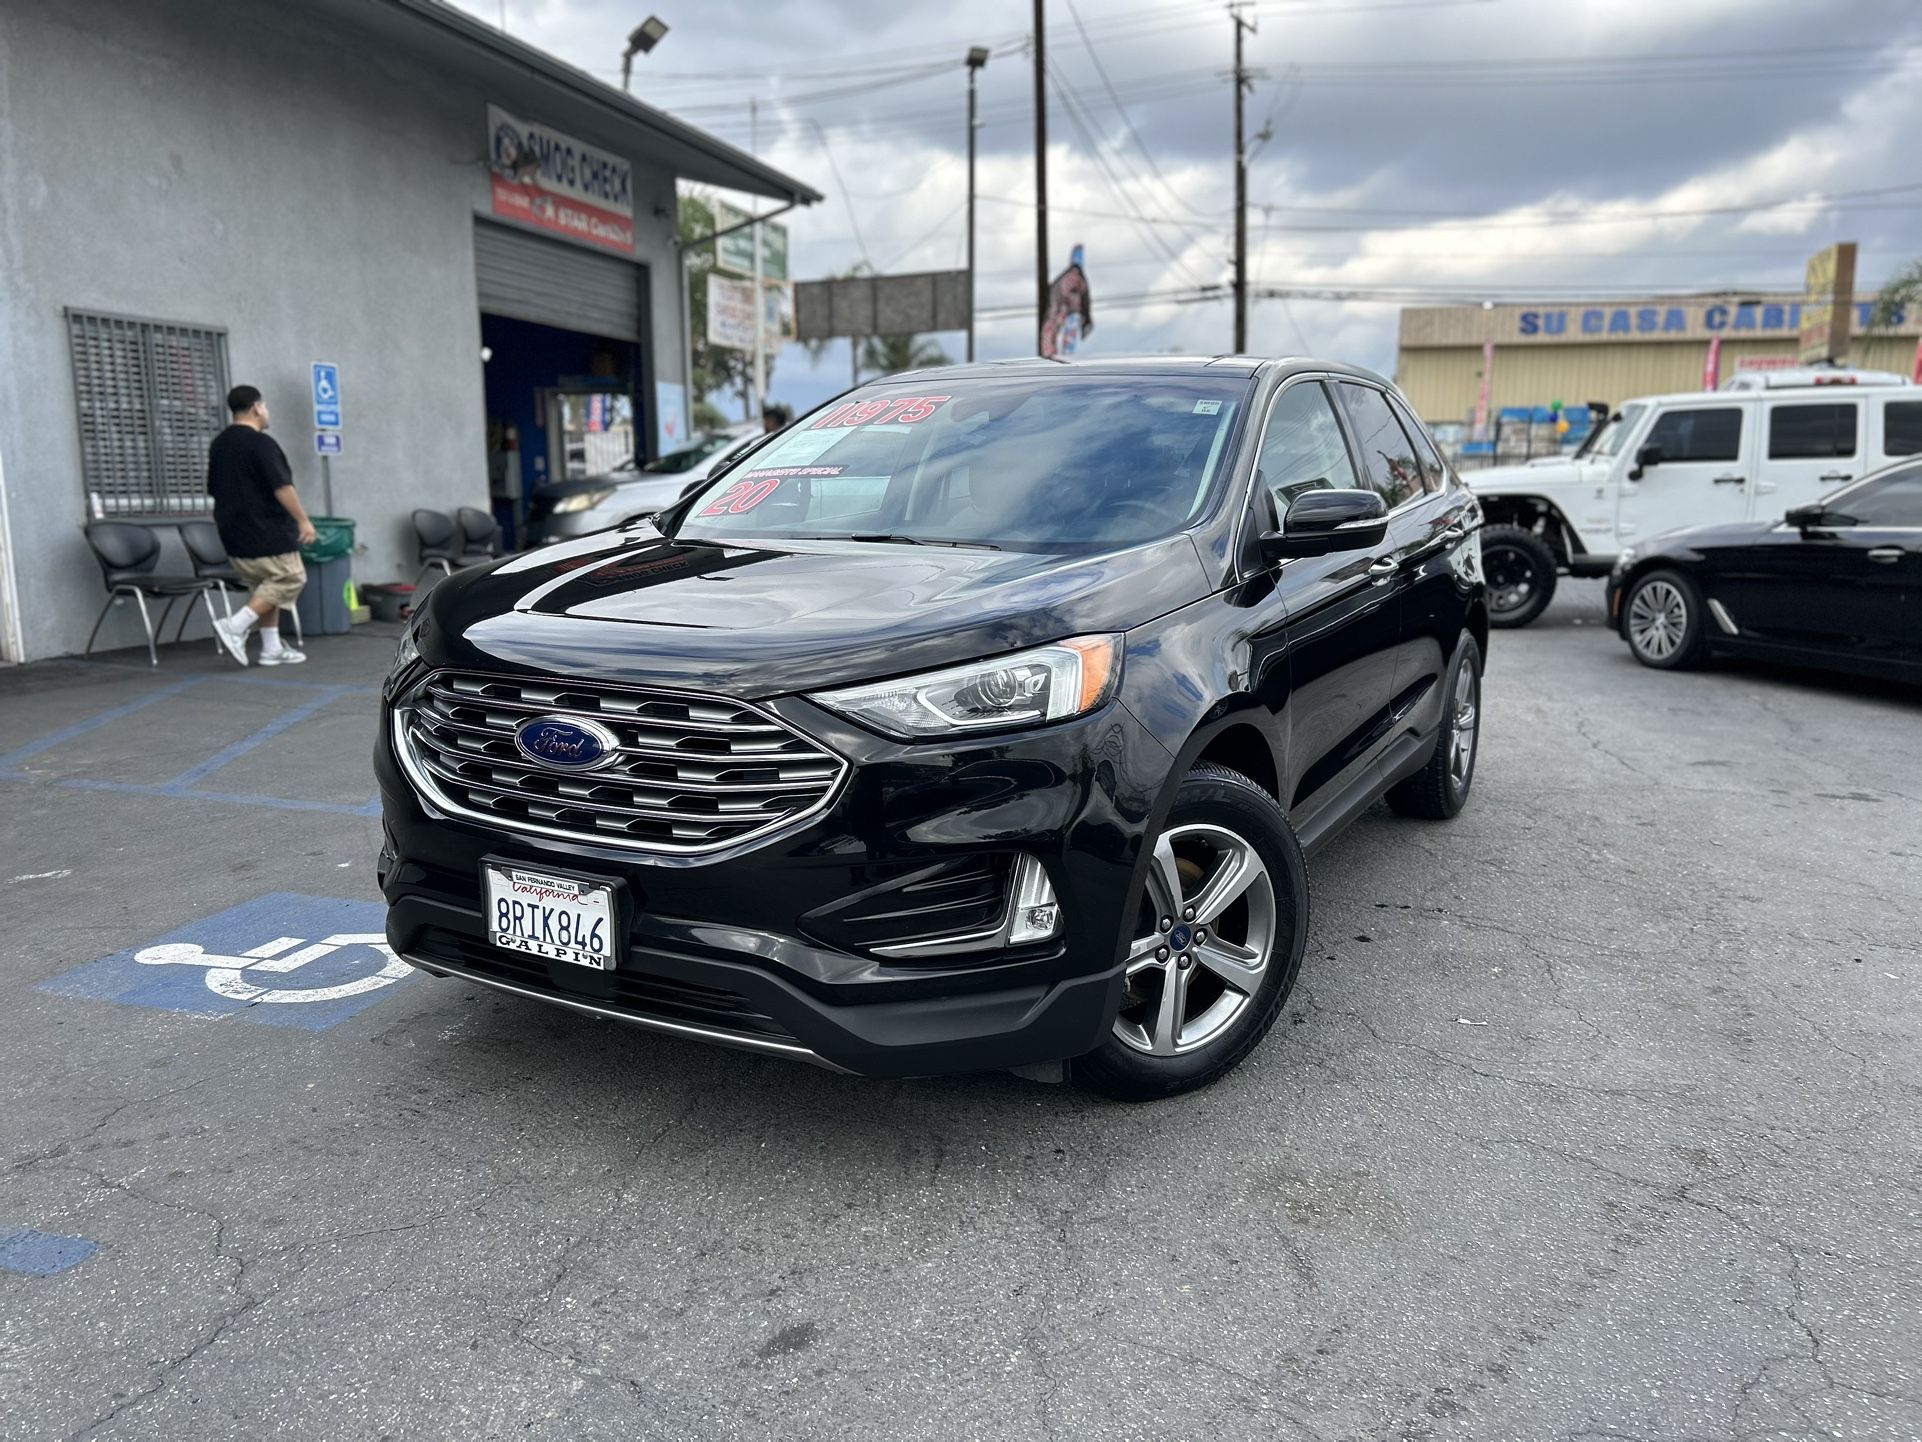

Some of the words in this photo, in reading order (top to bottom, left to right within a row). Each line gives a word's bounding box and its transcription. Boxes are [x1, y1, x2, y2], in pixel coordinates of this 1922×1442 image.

[527, 131, 577, 189] SMOG
[580, 152, 633, 207] CHECK
[1519, 310, 1566, 336] SU
[1581, 307, 1687, 334] CASA
[1705, 302, 1905, 331] CABITS
[810, 395, 952, 430] 11975
[698, 478, 781, 517] 20
[534, 727, 585, 757] Ford
[512, 882, 589, 905] California
[515, 874, 527, 882] SAN
[527, 876, 556, 888] FERNANDO
[556, 881, 576, 892] VALLEY
[497, 897, 604, 953] 8RIK846
[498, 934, 602, 967] GALPIN
